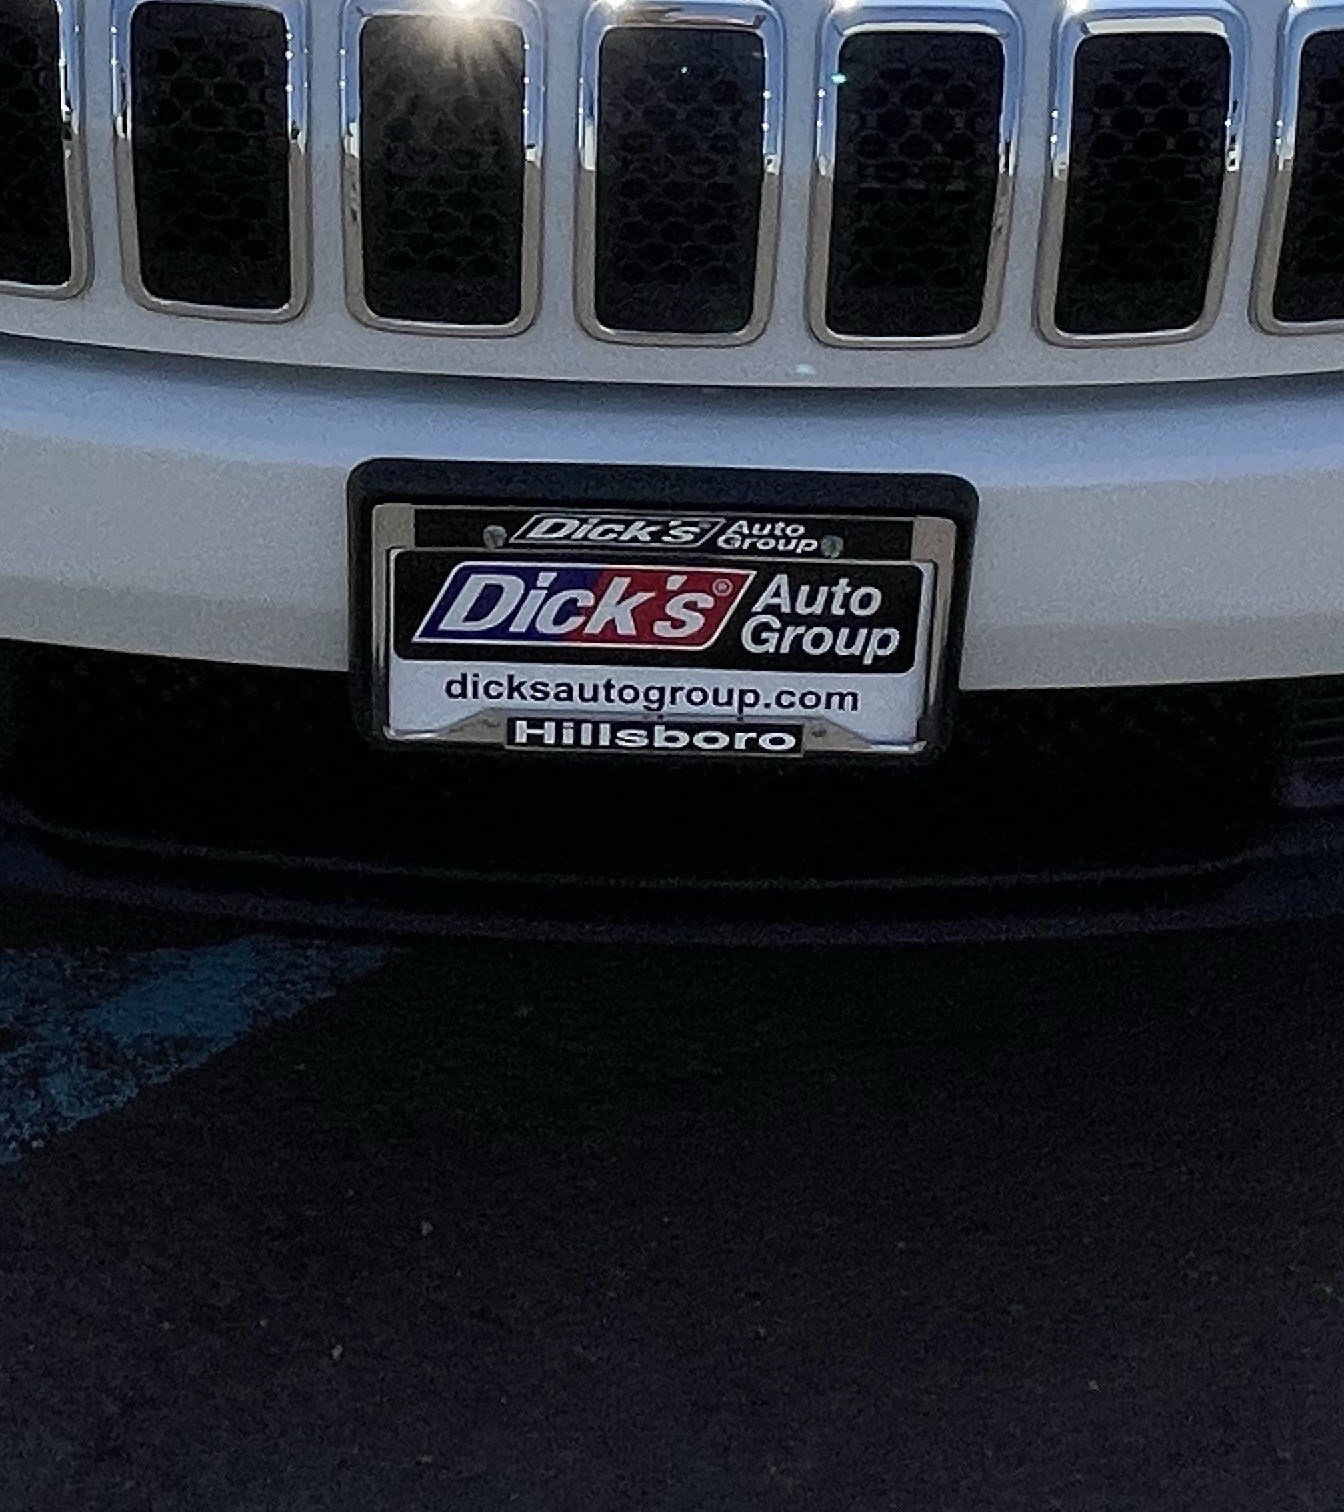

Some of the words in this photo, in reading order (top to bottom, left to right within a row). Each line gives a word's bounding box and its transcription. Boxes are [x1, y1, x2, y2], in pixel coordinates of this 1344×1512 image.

[716, 534, 818, 555] Group
[729, 520, 806, 538] Auto
[751, 573, 882, 618] Auto
[740, 614, 901, 666] Group
[444, 673, 859, 712] dicksautogroup.com
[513, 719, 797, 751] Hillsboro
